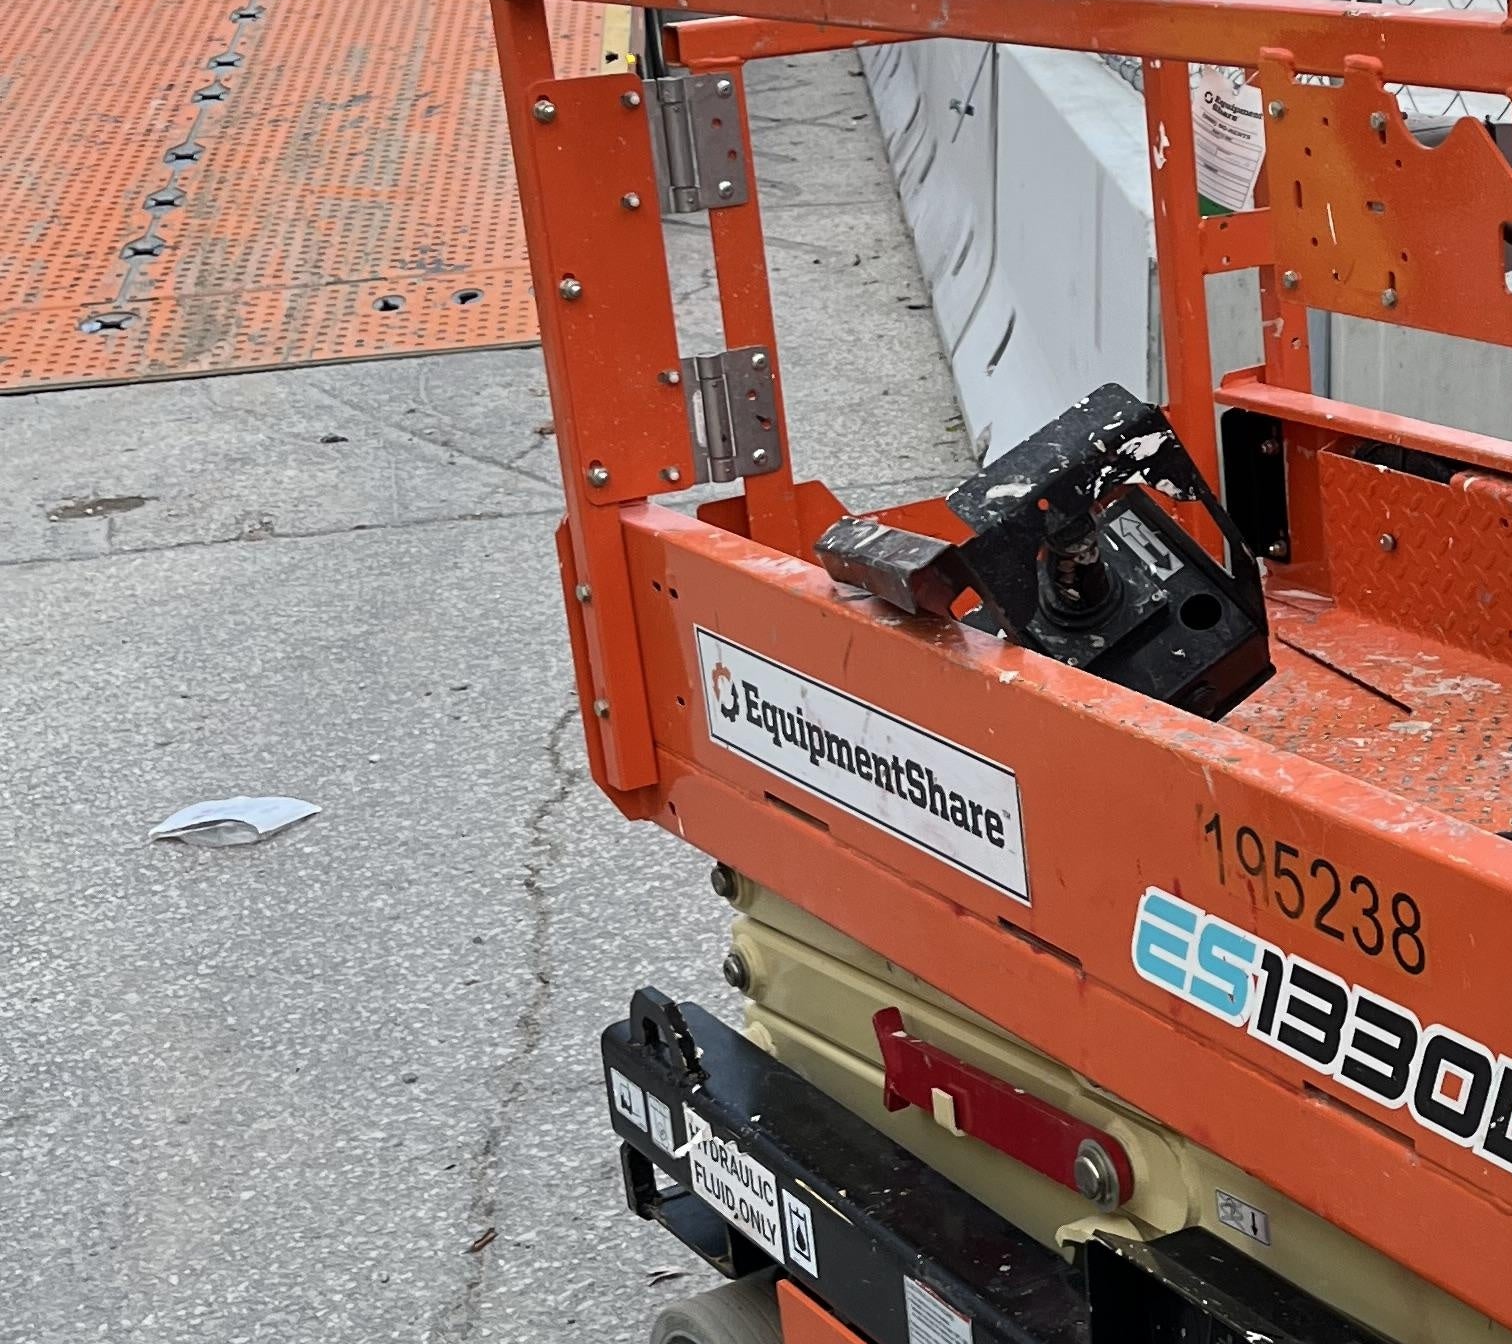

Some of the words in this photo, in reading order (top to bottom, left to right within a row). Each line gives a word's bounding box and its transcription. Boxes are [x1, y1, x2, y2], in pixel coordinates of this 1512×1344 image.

[1212, 103, 1238, 122] Share
[1214, 95, 1264, 120] Equipment
[741, 680, 1006, 850] EquipmentShare
[1204, 812, 1427, 976] 195238
[694, 1160, 736, 1212] FLUID
[739, 1197, 777, 1246] ONLY
